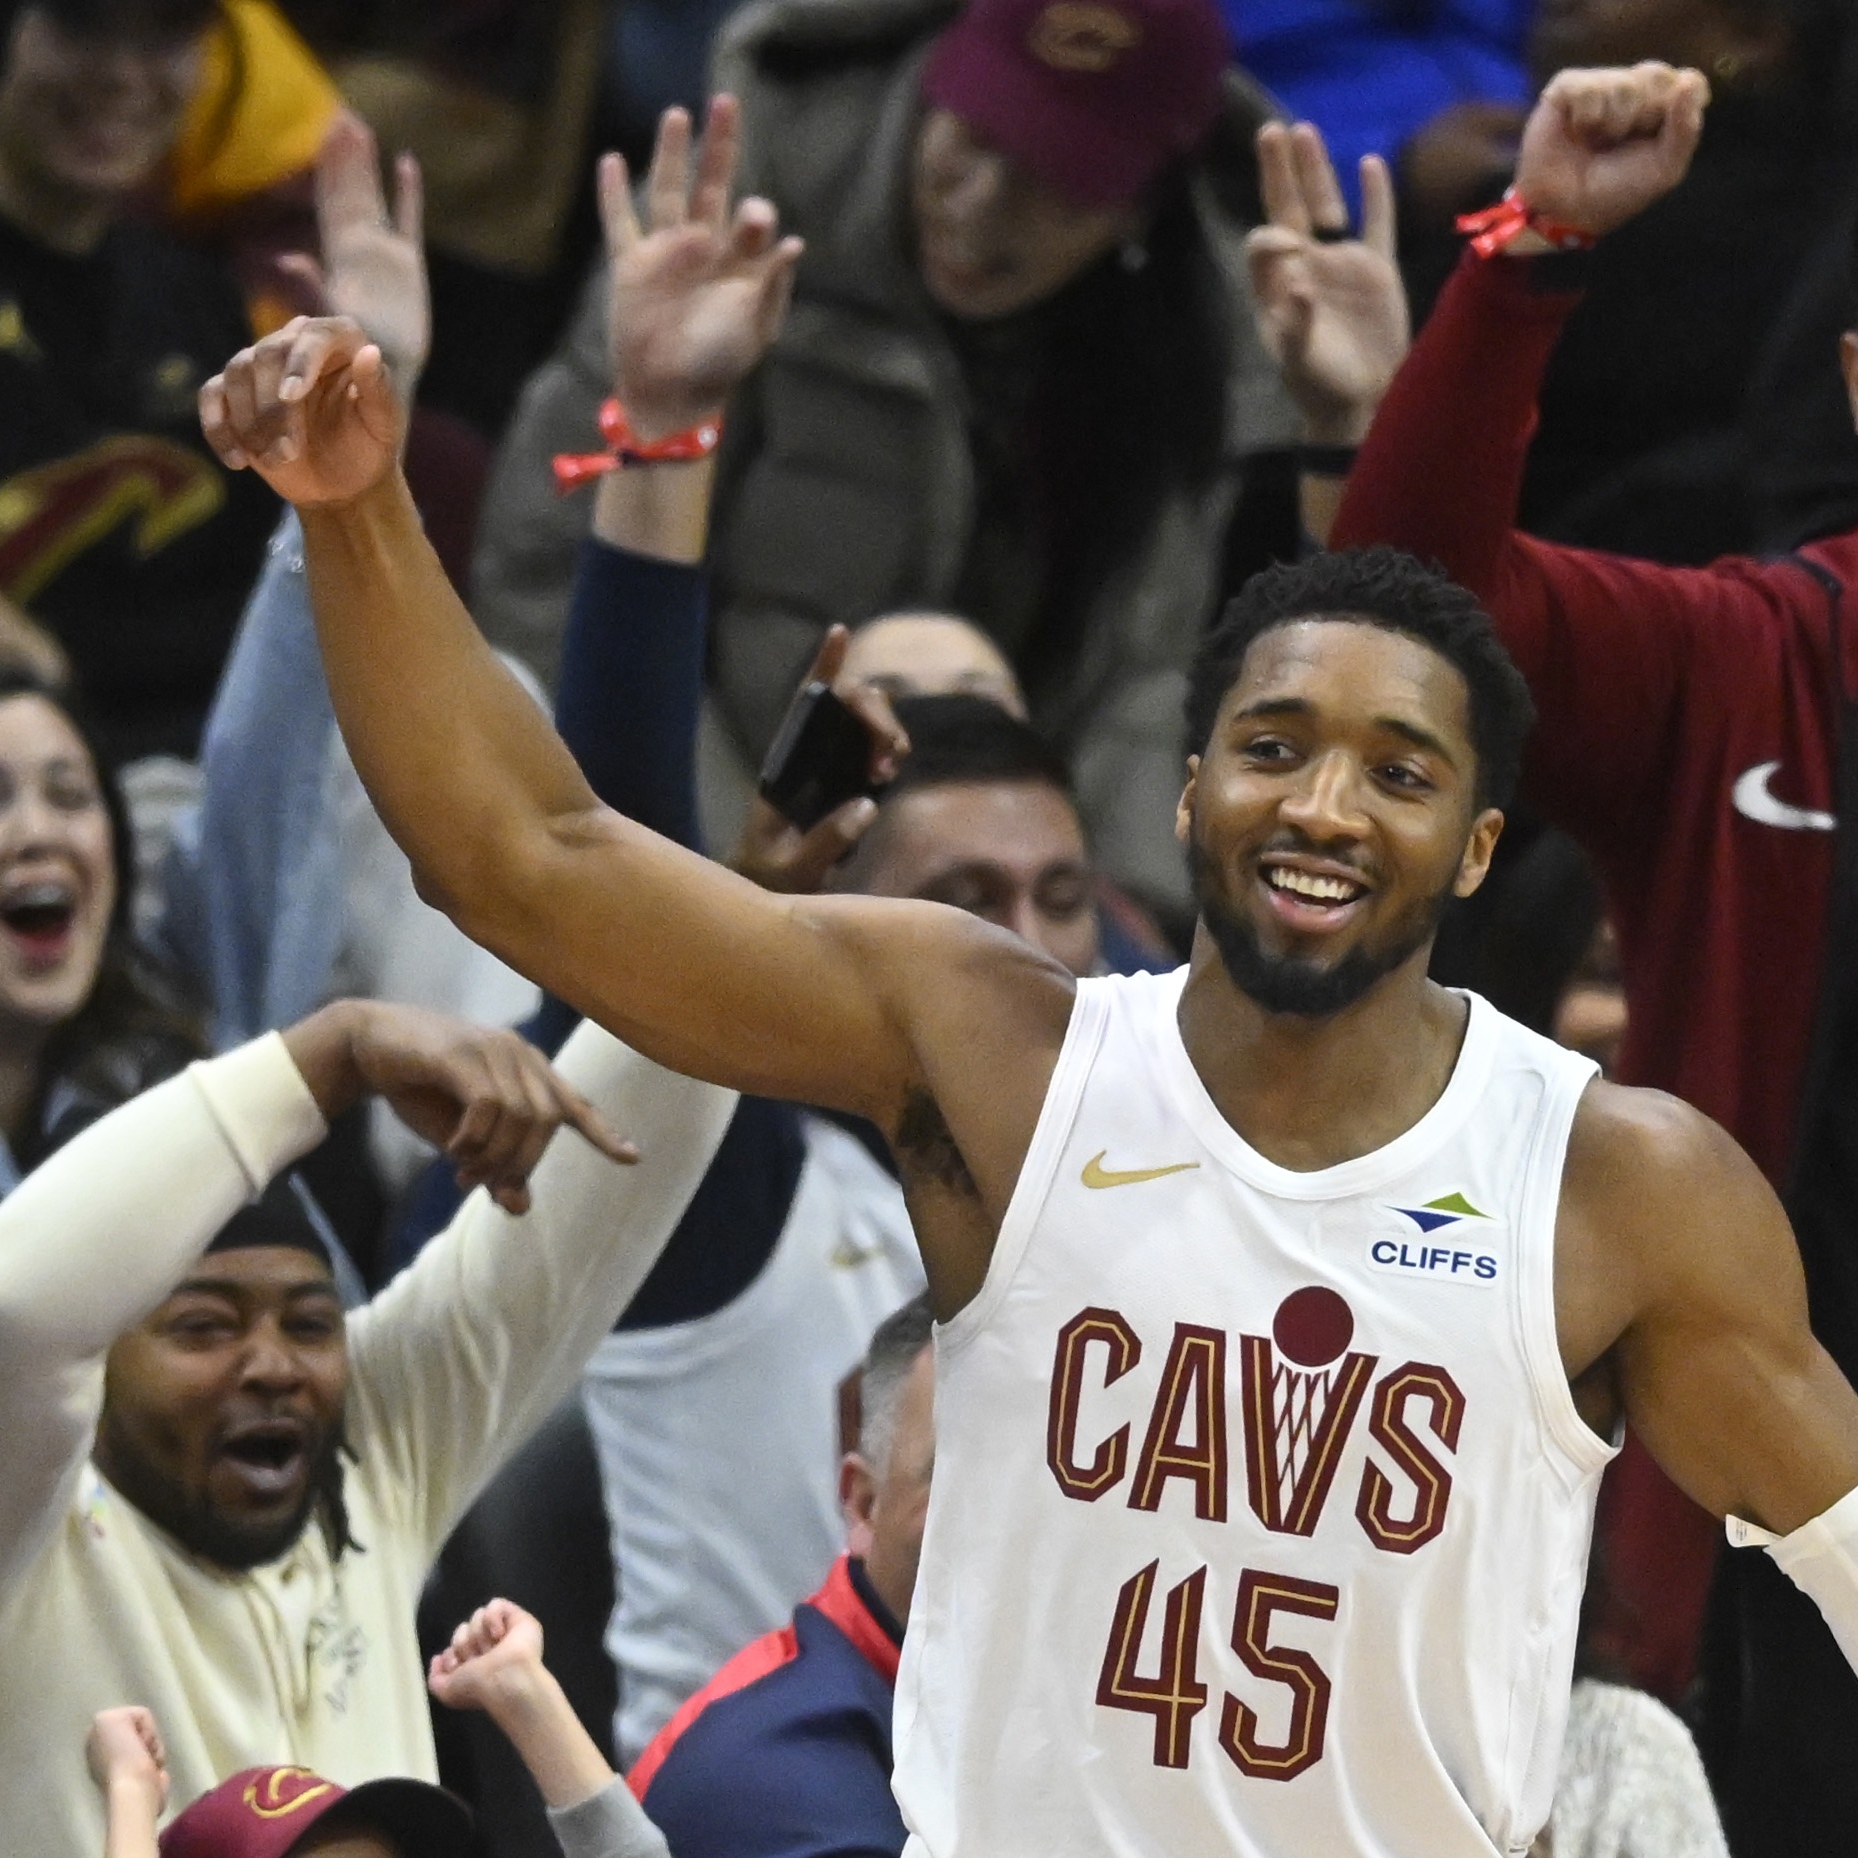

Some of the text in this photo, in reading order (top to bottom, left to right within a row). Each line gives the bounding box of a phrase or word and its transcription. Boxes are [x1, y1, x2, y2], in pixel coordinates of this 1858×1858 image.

[1371, 1240, 1498, 1280] CLIFFS
[1046, 1286, 1467, 1556] CAVS
[1095, 1557, 1340, 1782] 45
